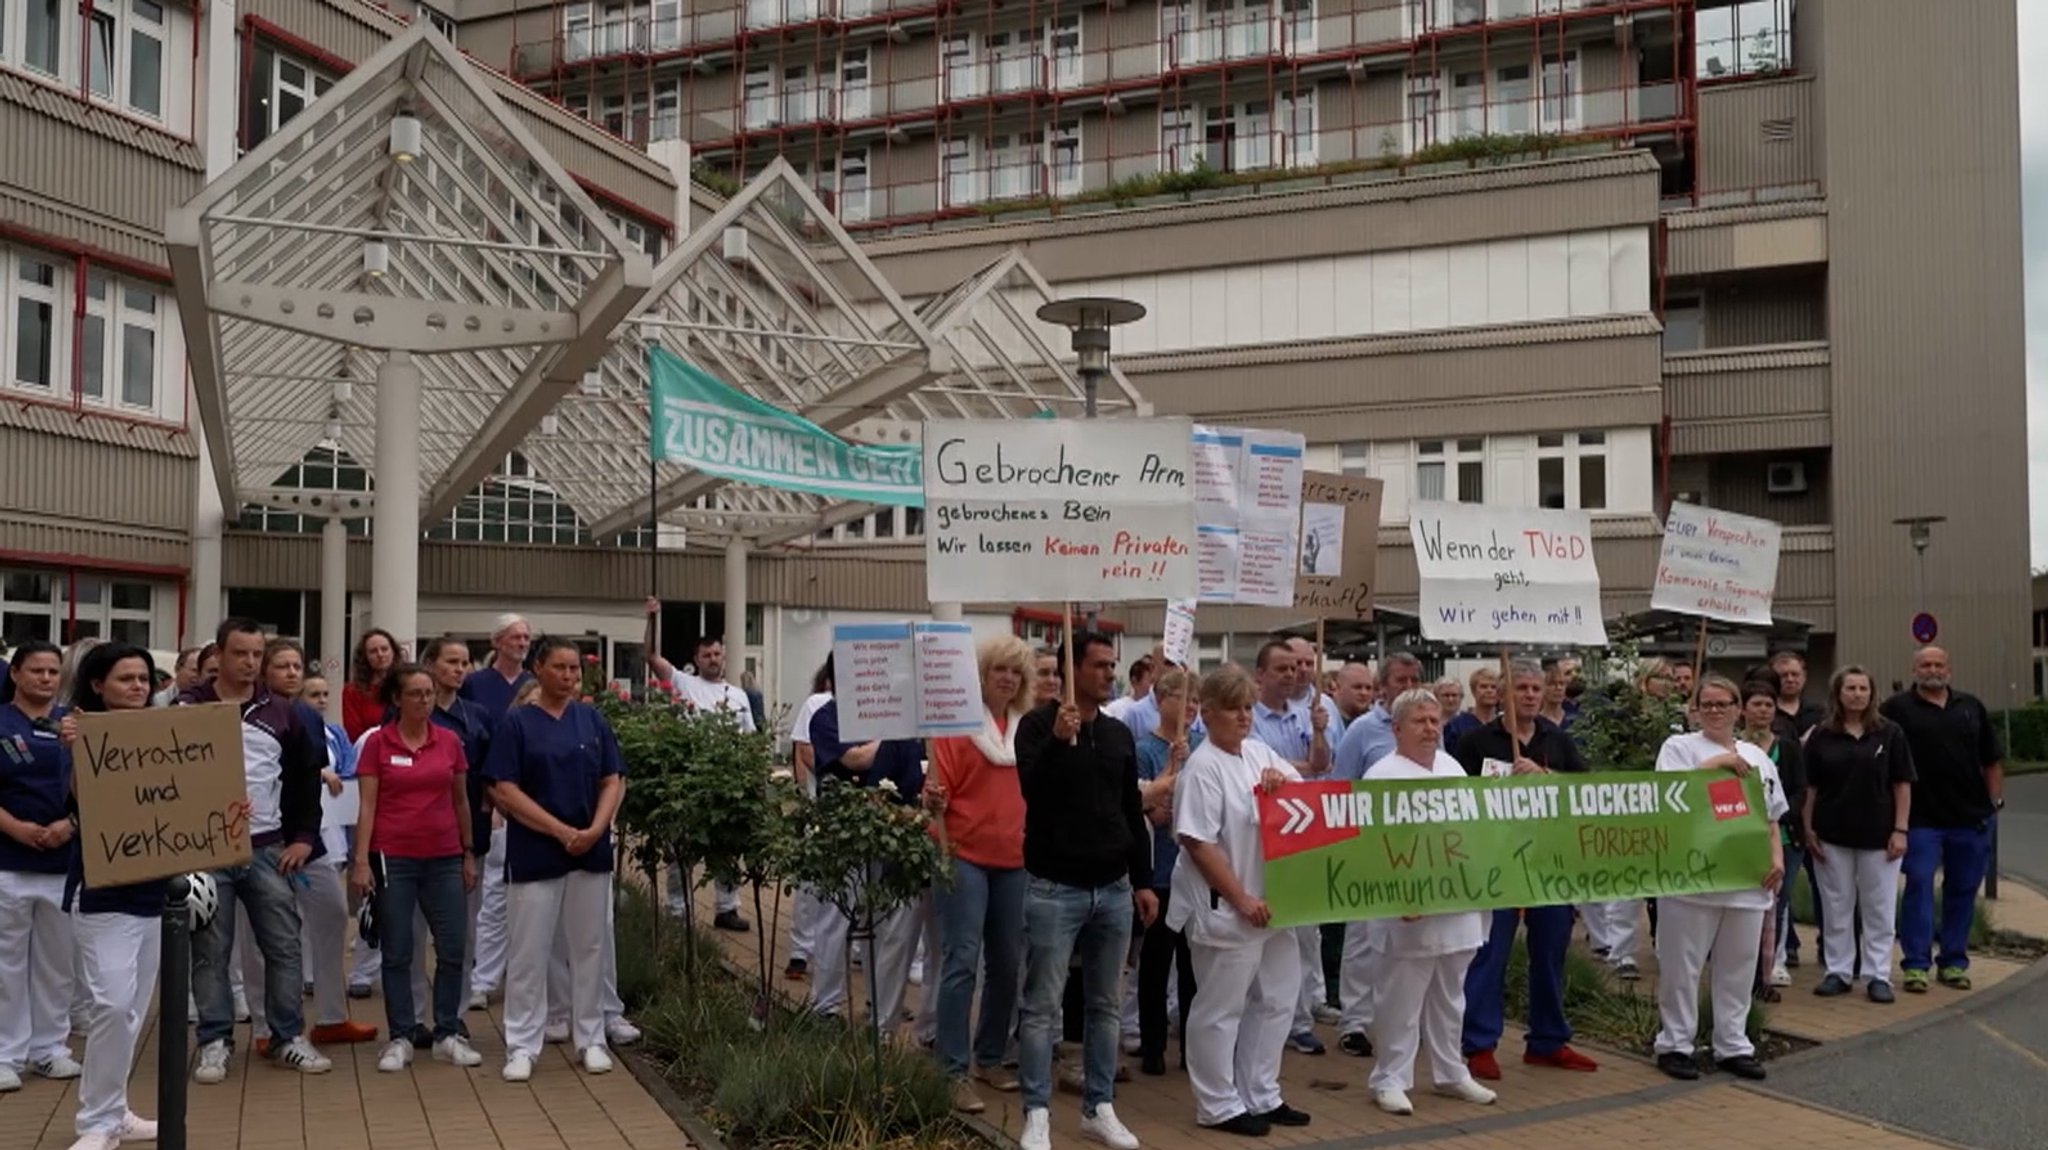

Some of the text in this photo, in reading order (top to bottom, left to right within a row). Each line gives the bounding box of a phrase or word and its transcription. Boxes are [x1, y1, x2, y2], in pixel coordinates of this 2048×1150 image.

[664, 408, 840, 478] ZUSAMMEN
[937, 438, 1120, 487] Gebrochener
[937, 500, 1111, 529] gebrochenes Bein
[937, 536, 967, 555] Wir
[979, 533, 1032, 554] lassen
[1112, 530, 1189, 556] Privaten
[1419, 518, 1585, 561] Wenn der TVöD
[1307, 577, 1333, 588] und
[1494, 570, 1530, 592] geht,
[1439, 602, 1476, 624] wir
[1492, 603, 1537, 630] gehen
[82, 726, 214, 779] Verraten
[135, 773, 181, 806] und
[1321, 781, 1660, 829] WIR LASSEN NICHT LOCKER!
[1382, 824, 1670, 871] WIR FORDERN
[1512, 839, 1718, 901] Trägerschaft
